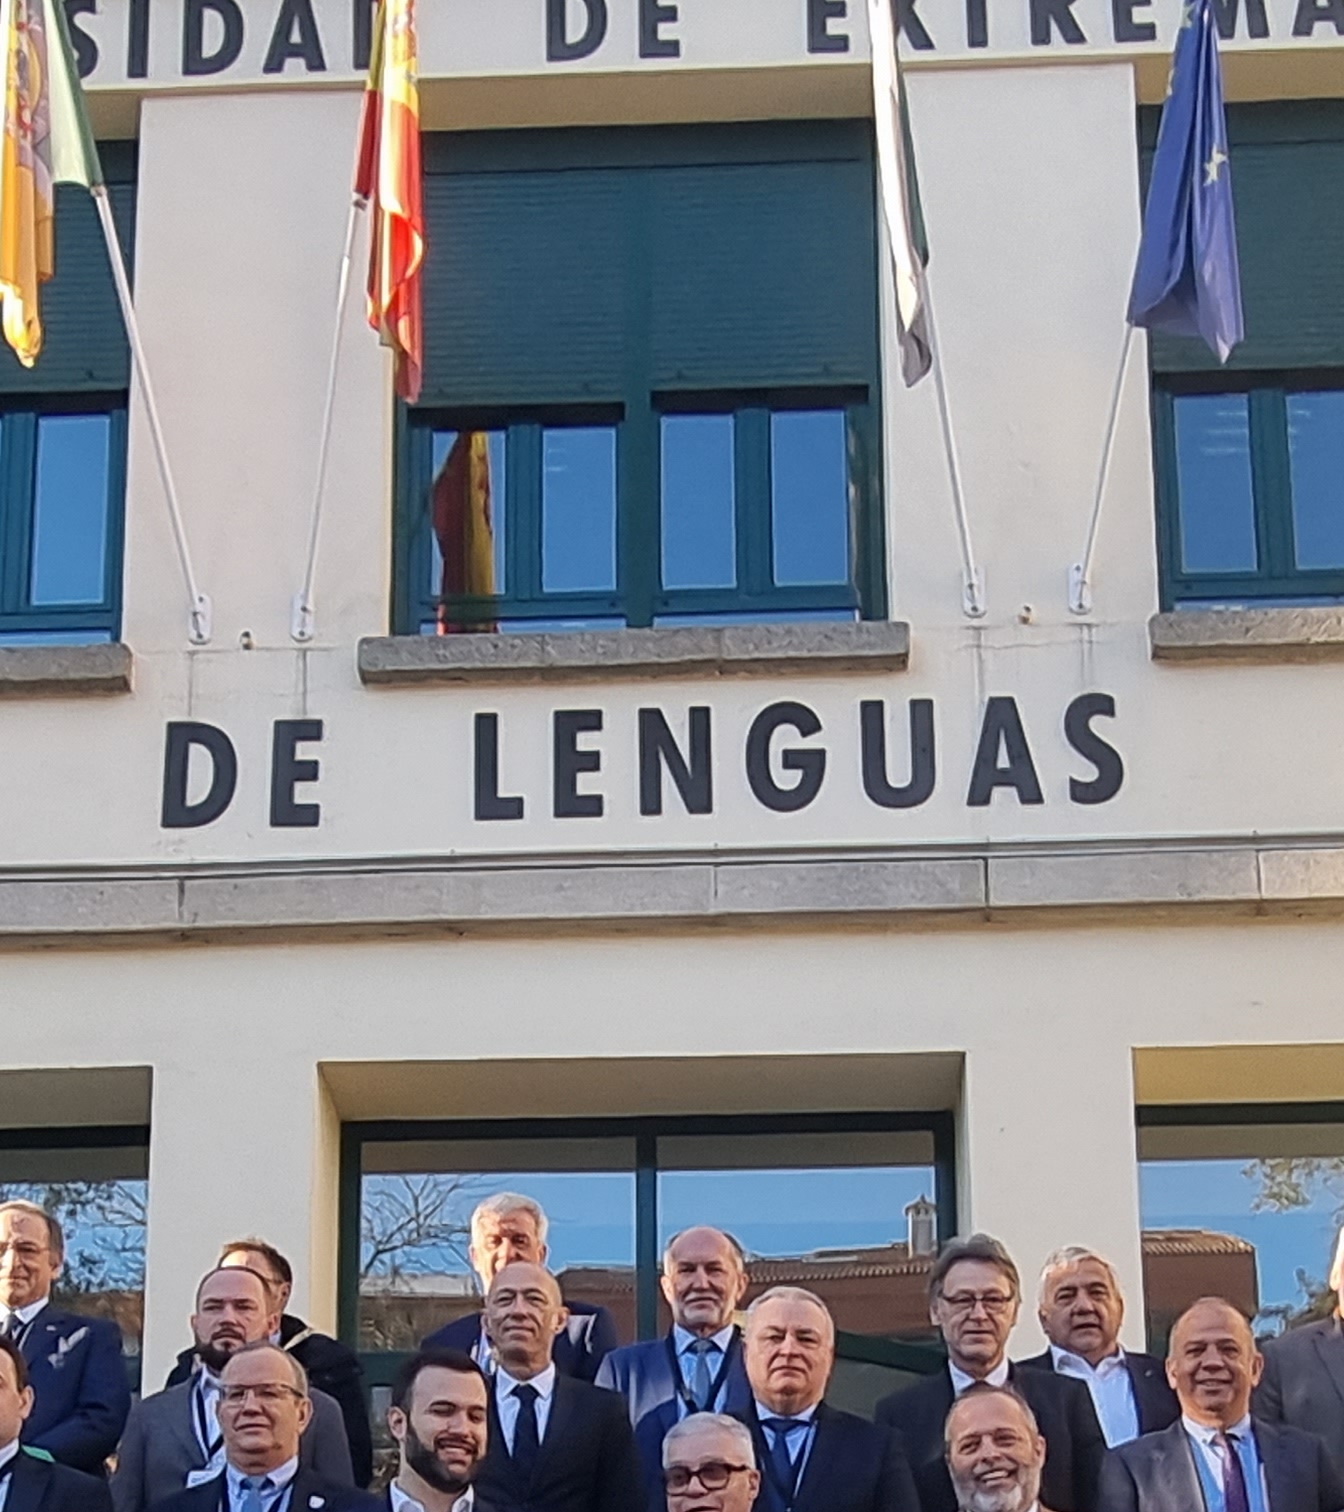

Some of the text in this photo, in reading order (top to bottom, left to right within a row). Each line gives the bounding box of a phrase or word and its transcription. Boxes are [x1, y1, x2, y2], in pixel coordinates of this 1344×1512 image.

[546, 0, 681, 62] DE
[161, 717, 325, 829] DE
[474, 692, 1126, 822] LENGUAS
